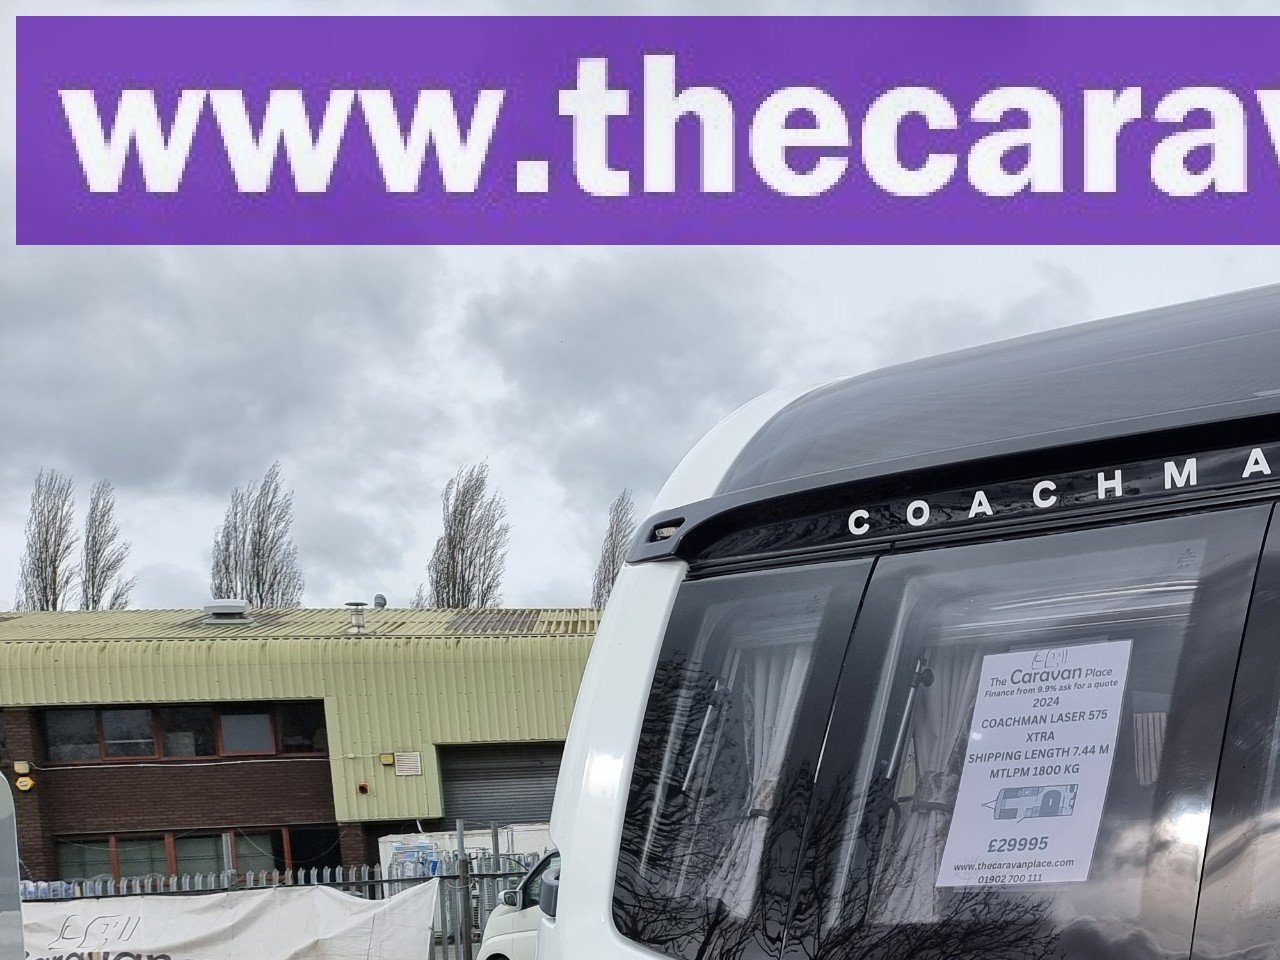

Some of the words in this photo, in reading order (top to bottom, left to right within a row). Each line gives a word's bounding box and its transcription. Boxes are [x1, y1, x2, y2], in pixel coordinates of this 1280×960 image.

[990, 677, 1007, 688] The
[1010, 667, 1083, 685] Caravan
[1085, 668, 1113, 678] Place
[984, 689, 1014, 698] Finance
[1016, 687, 1035, 695] from
[1037, 685, 1057, 693] 9.9%
[1058, 683, 1072, 691] ask
[1073, 682, 1086, 690] for
[1093, 680, 1119, 689] quote
[1032, 697, 1060, 708] 2024
[981, 715, 1047, 729] COACHMAN
[1050, 711, 1086, 723] LASER
[1088, 709, 1108, 720] 575
[1026, 731, 1055, 743] XTRA
[968, 750, 1021, 764] SHIPPING
[1024, 747, 1070, 760] LENGTH
[1073, 745, 1096, 757] 7.44
[1098, 744, 1110, 755] M
[989, 767, 1030, 779] MTLPM
[1032, 765, 1061, 777] 1800
[1063, 763, 1080, 775] KG
[987, 836, 1050, 853] £29995
[953, 859, 1075, 872] www.thecaravanplace.com
[978, 875, 1006, 884] 01902
[1008, 874, 1026, 882] 700
[1028, 873, 1043, 882] 111
